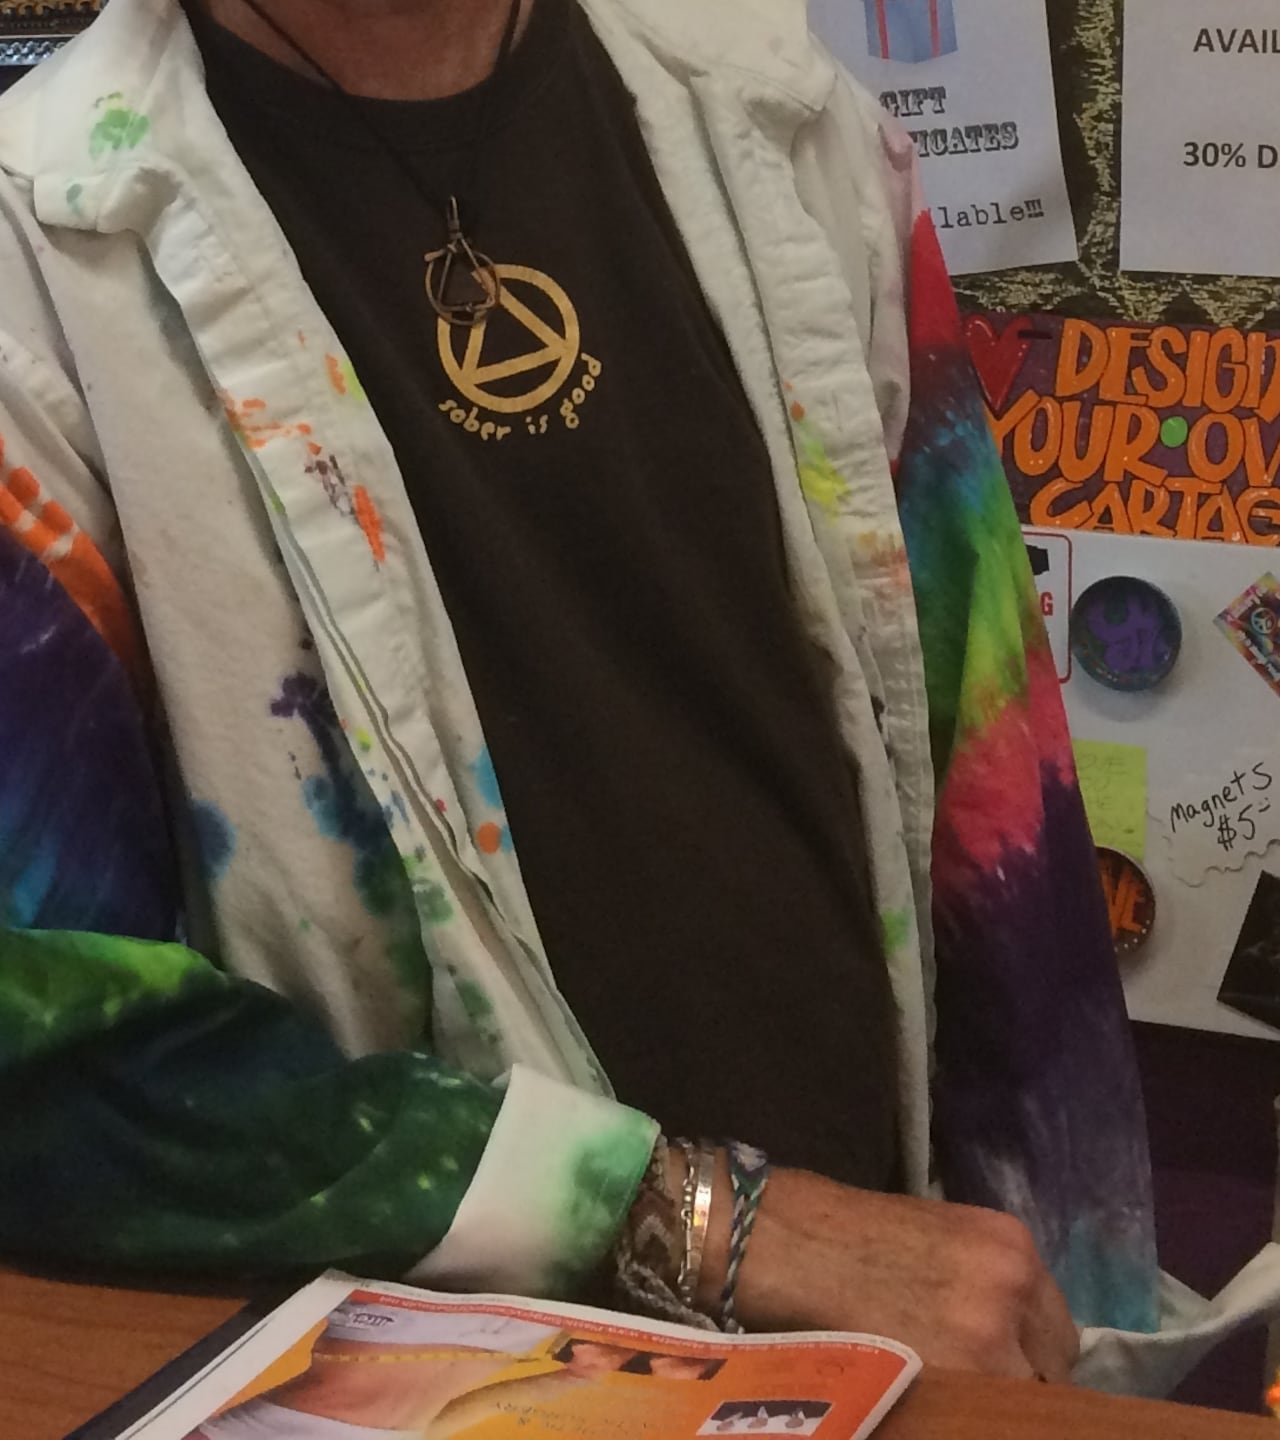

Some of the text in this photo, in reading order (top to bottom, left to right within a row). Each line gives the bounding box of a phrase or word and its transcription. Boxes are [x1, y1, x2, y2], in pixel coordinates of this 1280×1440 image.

[878, 86, 947, 117] GIFT
[913, 121, 1019, 157] ICATES
[1183, 142, 1247, 168] 30%
[933, 198, 1045, 229] lable!!!
[438, 352, 602, 441] sober is good
[983, 389, 1168, 487] YOUR
